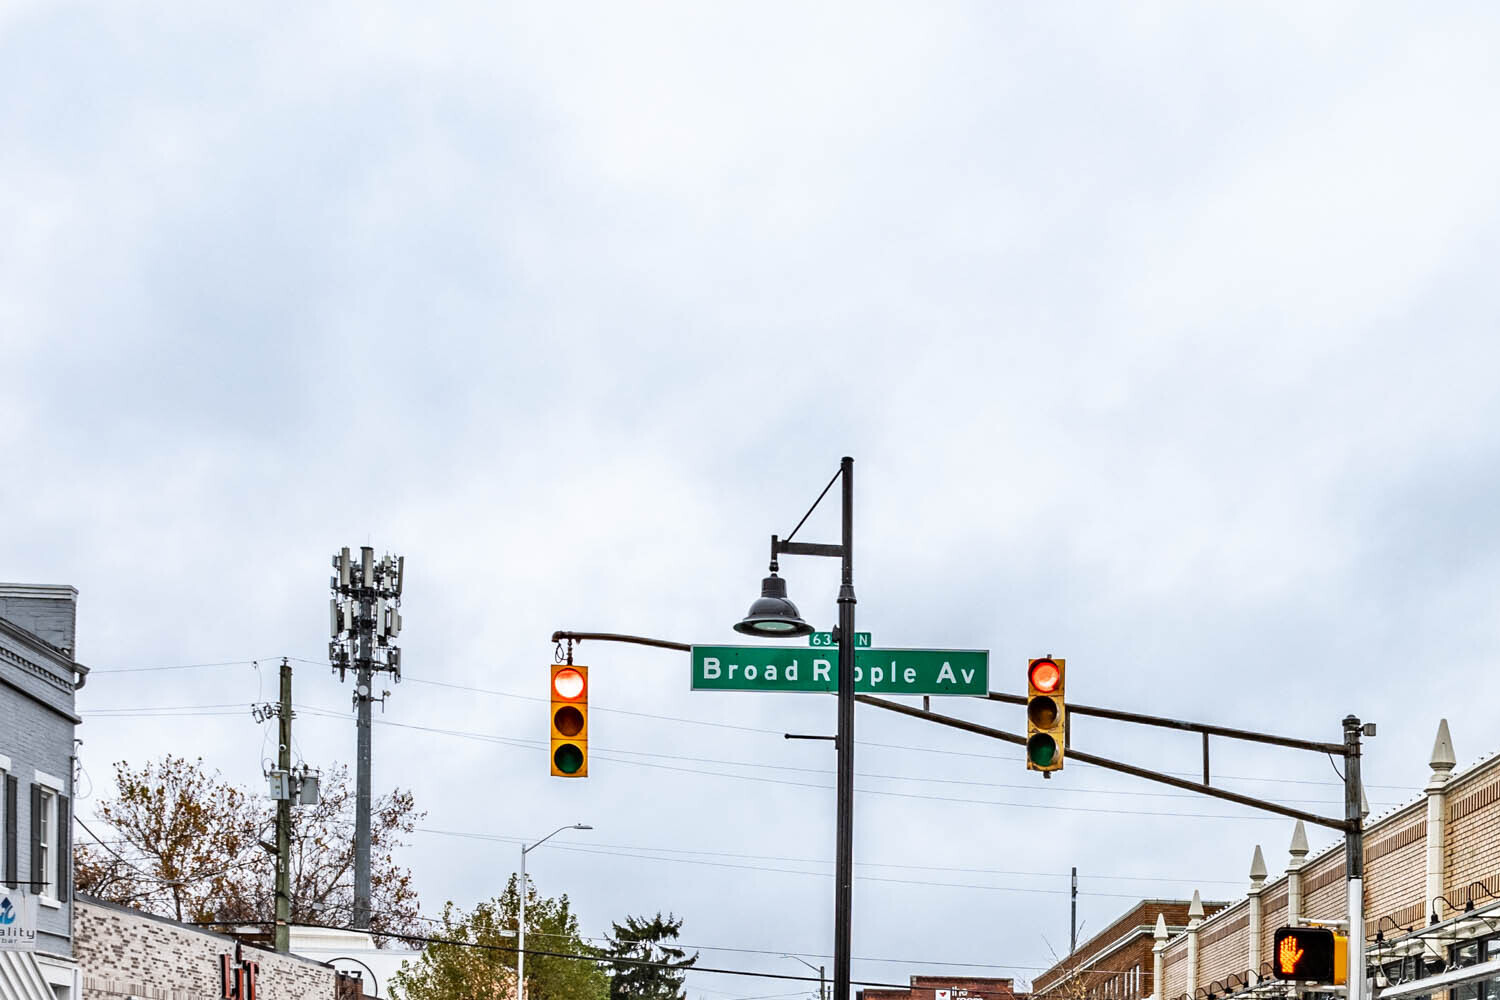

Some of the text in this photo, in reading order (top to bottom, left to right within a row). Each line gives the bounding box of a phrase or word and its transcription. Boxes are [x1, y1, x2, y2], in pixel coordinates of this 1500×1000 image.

[859, 634, 868, 646] N
[703, 657, 975, 687] Broad Rpple Av
